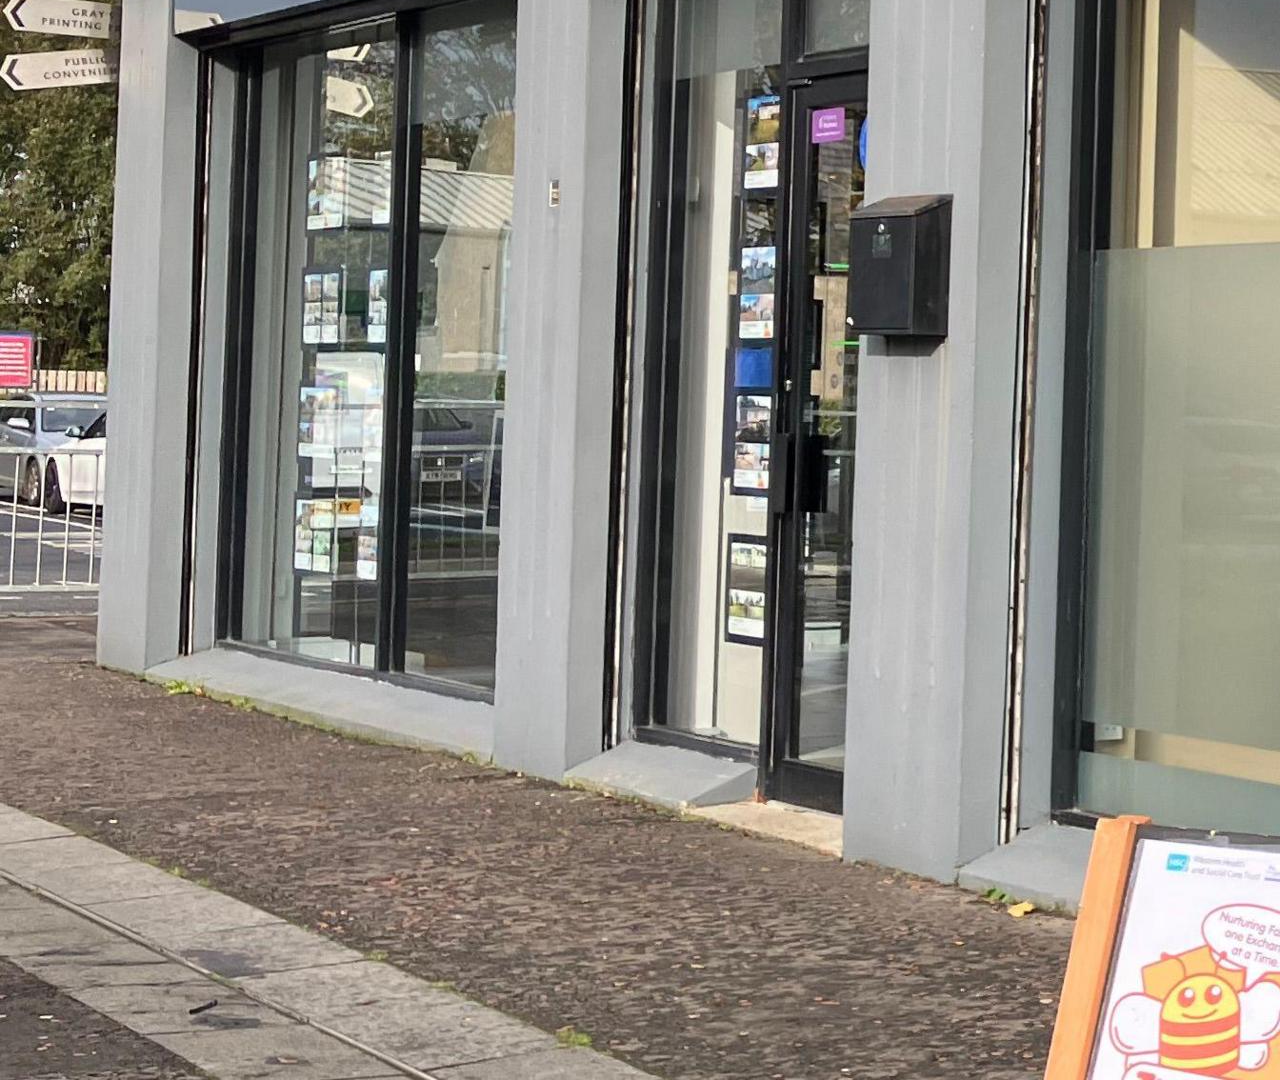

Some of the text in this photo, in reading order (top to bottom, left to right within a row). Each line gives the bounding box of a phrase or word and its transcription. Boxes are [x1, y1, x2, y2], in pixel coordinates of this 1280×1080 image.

[41, 17, 102, 30] PRINTING
[1219, 911, 1267, 935] Nurturing
[1224, 929, 1245, 941] one
[1231, 947, 1242, 956] at
[1244, 951, 1252, 959] a
